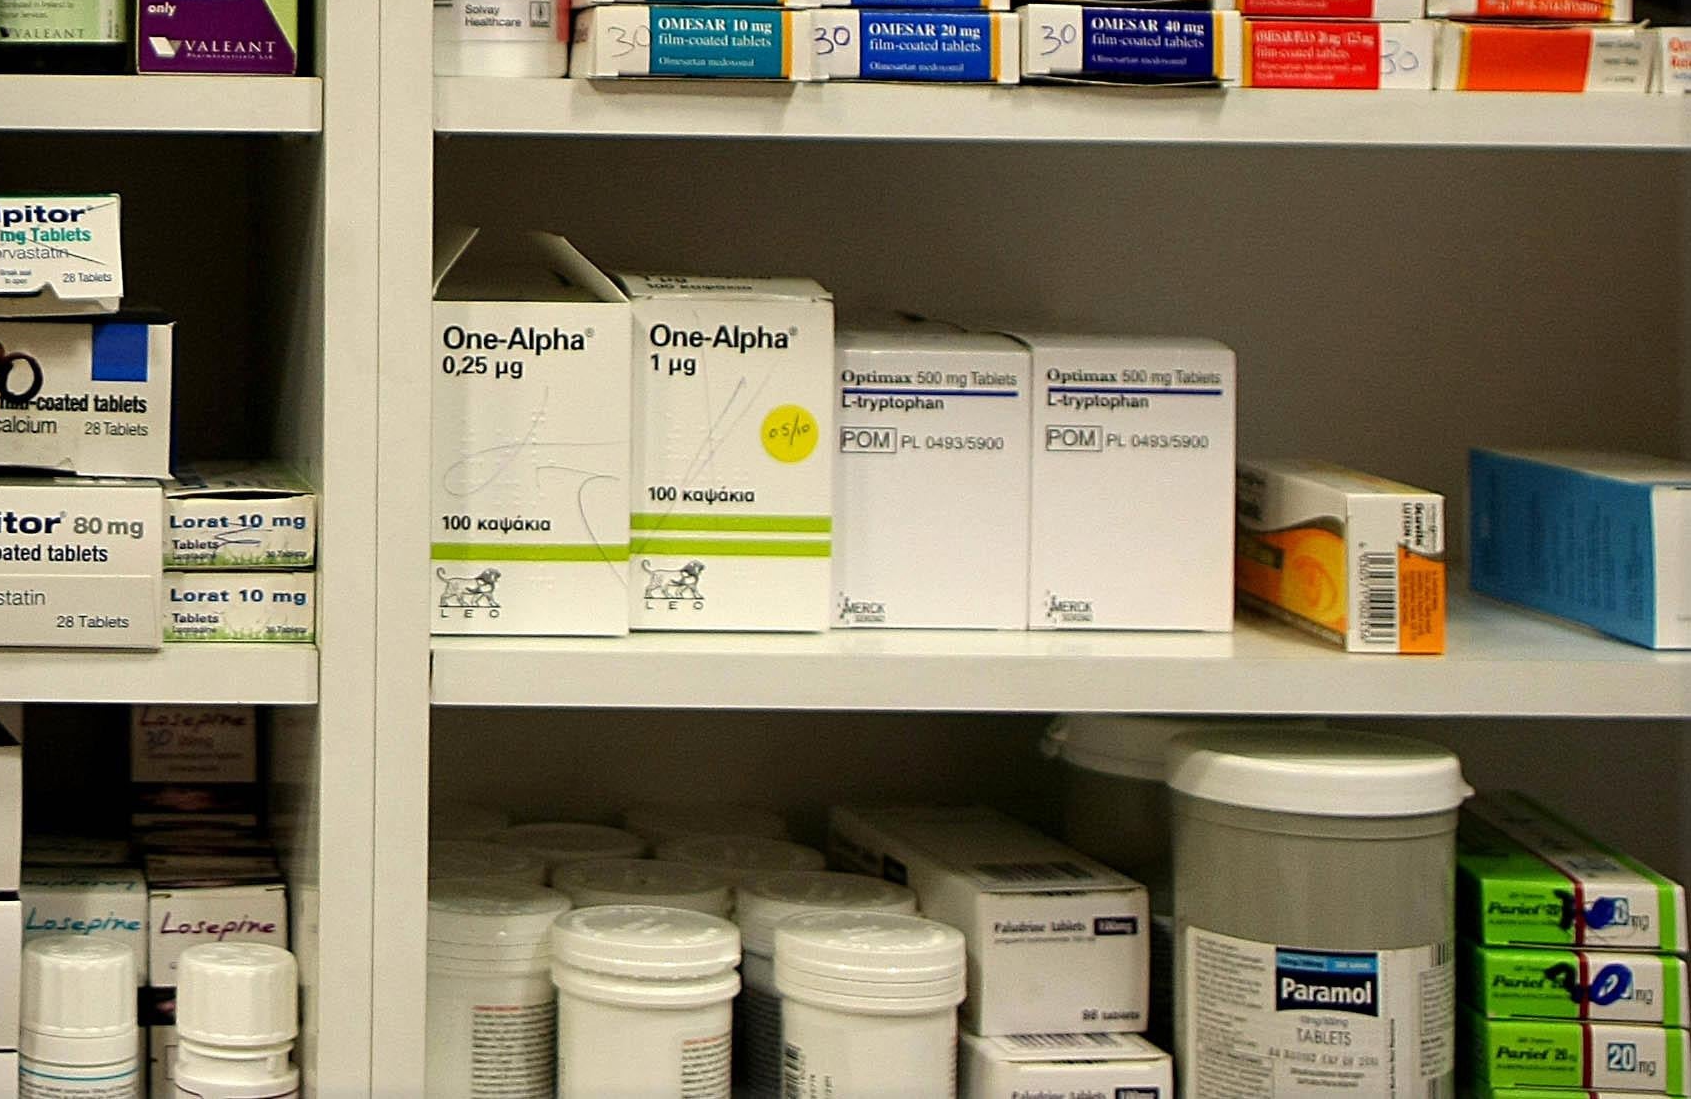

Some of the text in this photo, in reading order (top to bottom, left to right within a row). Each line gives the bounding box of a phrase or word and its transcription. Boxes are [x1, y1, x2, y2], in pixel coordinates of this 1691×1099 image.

[148, 3, 176, 15] only
[465, 4, 500, 17] Solvay
[465, 16, 522, 28] Healthcare
[1092, 18, 1204, 34] OMESAR 40 mg
[185, 40, 276, 53] VALEANT
[814, 27, 850, 55] 30
[1092, 34, 1204, 47] film-coated tablets
[443, 326, 585, 355] One-Alpha
[650, 324, 789, 354] One-Alpha
[442, 356, 487, 375] 0,25
[842, 370, 1018, 387] Optimax 500 mg Tablets
[842, 395, 944, 411] L-tryptophan
[843, 430, 891, 449] POM
[901, 436, 920, 449] PL
[73, 517, 103, 534] 80
[107, 519, 144, 539] mg
[170, 515, 307, 530] Lorat 10 mg
[442, 516, 471, 531] 100
[57, 616, 129, 630] 28 Tablets
[160, 913, 276, 936] Losepine
[1281, 977, 1372, 1005] Paramol
[1608, 1044, 1635, 1070] 20
